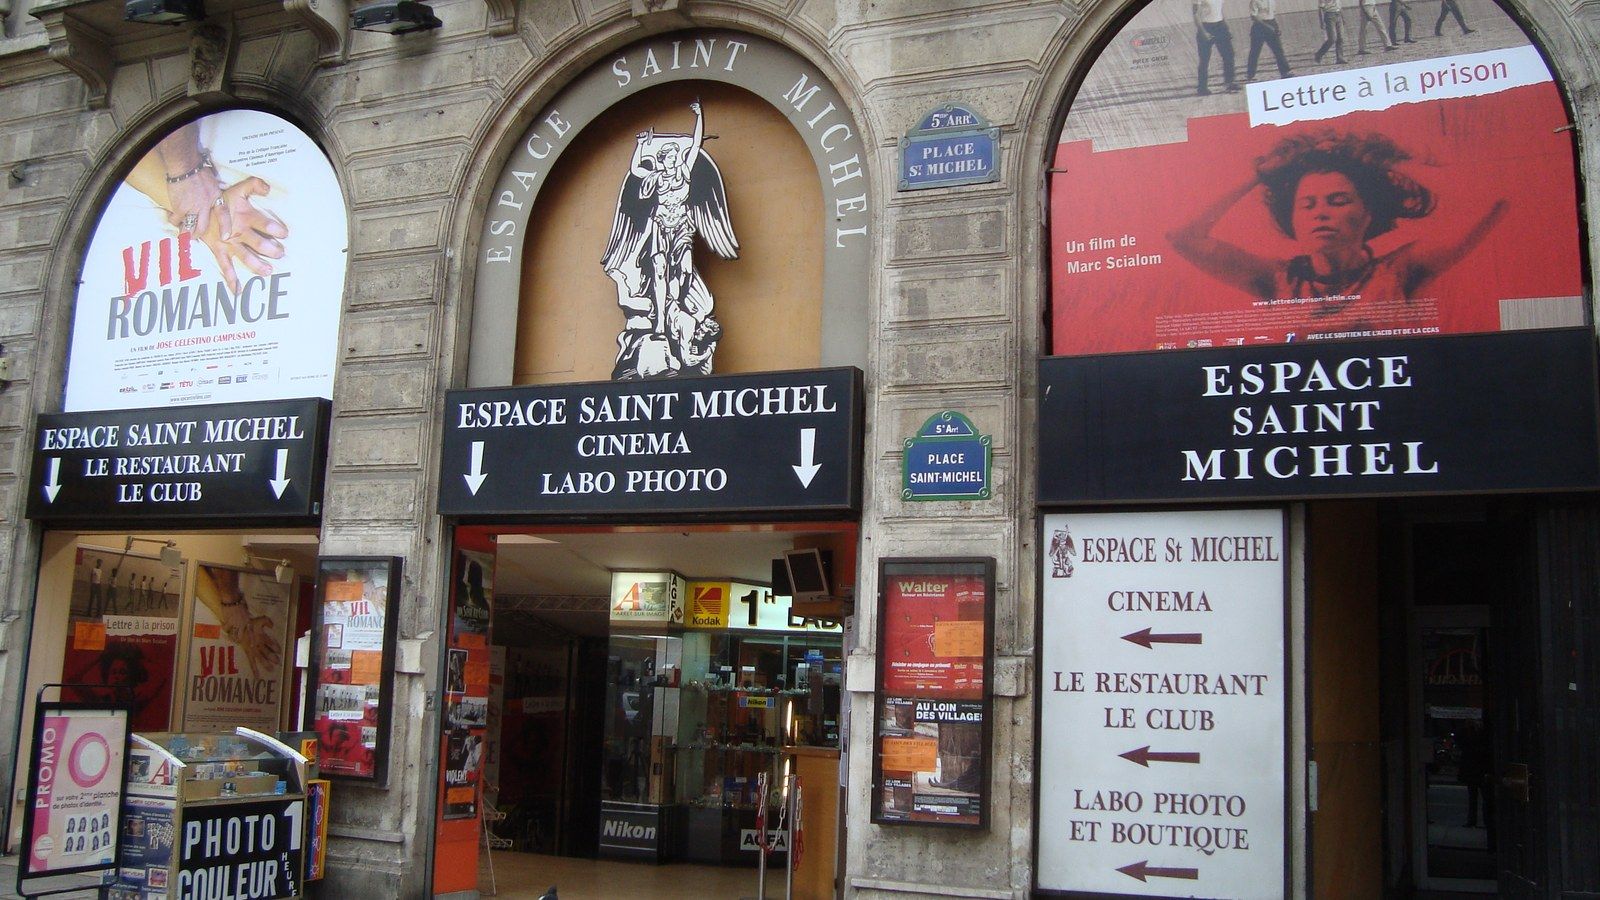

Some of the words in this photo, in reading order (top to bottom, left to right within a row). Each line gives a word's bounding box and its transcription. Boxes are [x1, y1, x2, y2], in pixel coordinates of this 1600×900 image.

[612, 39, 748, 88] SAINT
[1262, 83, 1347, 112] Lettre
[1358, 76, 1374, 98] à
[1384, 71, 1410, 93] la
[1419, 57, 1509, 94] prison
[782, 72, 868, 248] MICHEL
[923, 143, 974, 159] PLACE
[926, 159, 986, 176] MICHEL
[486, 109, 573, 264] ESPACE
[1066, 240, 1085, 253] Un
[1089, 237, 1116, 251] film
[1120, 234, 1136, 246] de
[122, 232, 202, 297] VIL
[1067, 261, 1101, 274] Marc
[1106, 253, 1162, 269] Scialom
[106, 272, 291, 340] ROMANCE
[156, 341, 173, 349] JOSE
[174, 337, 212, 347] CELESTINO
[213, 330, 256, 343] CAMPUSANO
[1202, 355, 1412, 397] ESPACE
[458, 398, 567, 428] ESPACE
[579, 393, 679, 424] SAINT
[690, 384, 837, 418] MICHEL
[1233, 400, 1380, 436] SAINT
[42, 425, 120, 450] ESPACE
[126, 421, 197, 447] SAINT
[203, 415, 304, 443] MICHEL
[577, 431, 691, 457] CINEMA
[85, 458, 109, 477] LE
[115, 453, 245, 475] RESTAURANT
[928, 453, 964, 465] PLACE
[1181, 441, 1438, 482] MICHEL
[541, 471, 616, 495] LABO
[625, 468, 728, 493] PHOTO
[910, 471, 982, 483] SAINT-MICHEL
[119, 483, 144, 502] LE
[150, 482, 202, 501] CLUB
[1082, 537, 1157, 563] ESPACE
[1165, 537, 1182, 562] St
[1191, 536, 1279, 562] MICHEL
[669, 574, 678, 625] AGFA
[899, 581, 948, 593] Walter
[351, 601, 370, 618] VIL
[1107, 590, 1213, 612] CINEMA
[106, 619, 132, 630] Lettre
[134, 620, 140, 629] à
[143, 620, 149, 630] la
[152, 620, 175, 631] prison
[692, 616, 721, 626] Kodak
[200, 645, 239, 678] VIL
[191, 675, 276, 705] ROMANCE
[1053, 671, 1085, 693] LE
[1095, 672, 1268, 695] RESTAURANT
[916, 702, 930, 711] AU
[933, 702, 957, 712] LOIN
[916, 711, 935, 720] DES
[1104, 707, 1136, 729] LE
[1146, 708, 1215, 731] CLUB
[36, 728, 56, 808] PROMO
[93, 790, 119, 800] planche
[1073, 789, 1143, 813] LABO
[1154, 792, 1246, 817] PHOTO
[185, 814, 276, 860] PHOTO
[284, 801, 303, 850] 1
[603, 820, 656, 840] Nikon
[1069, 820, 1102, 842] ET
[1111, 822, 1249, 856] BOUTIQUE
[177, 860, 278, 900] COULEUR
